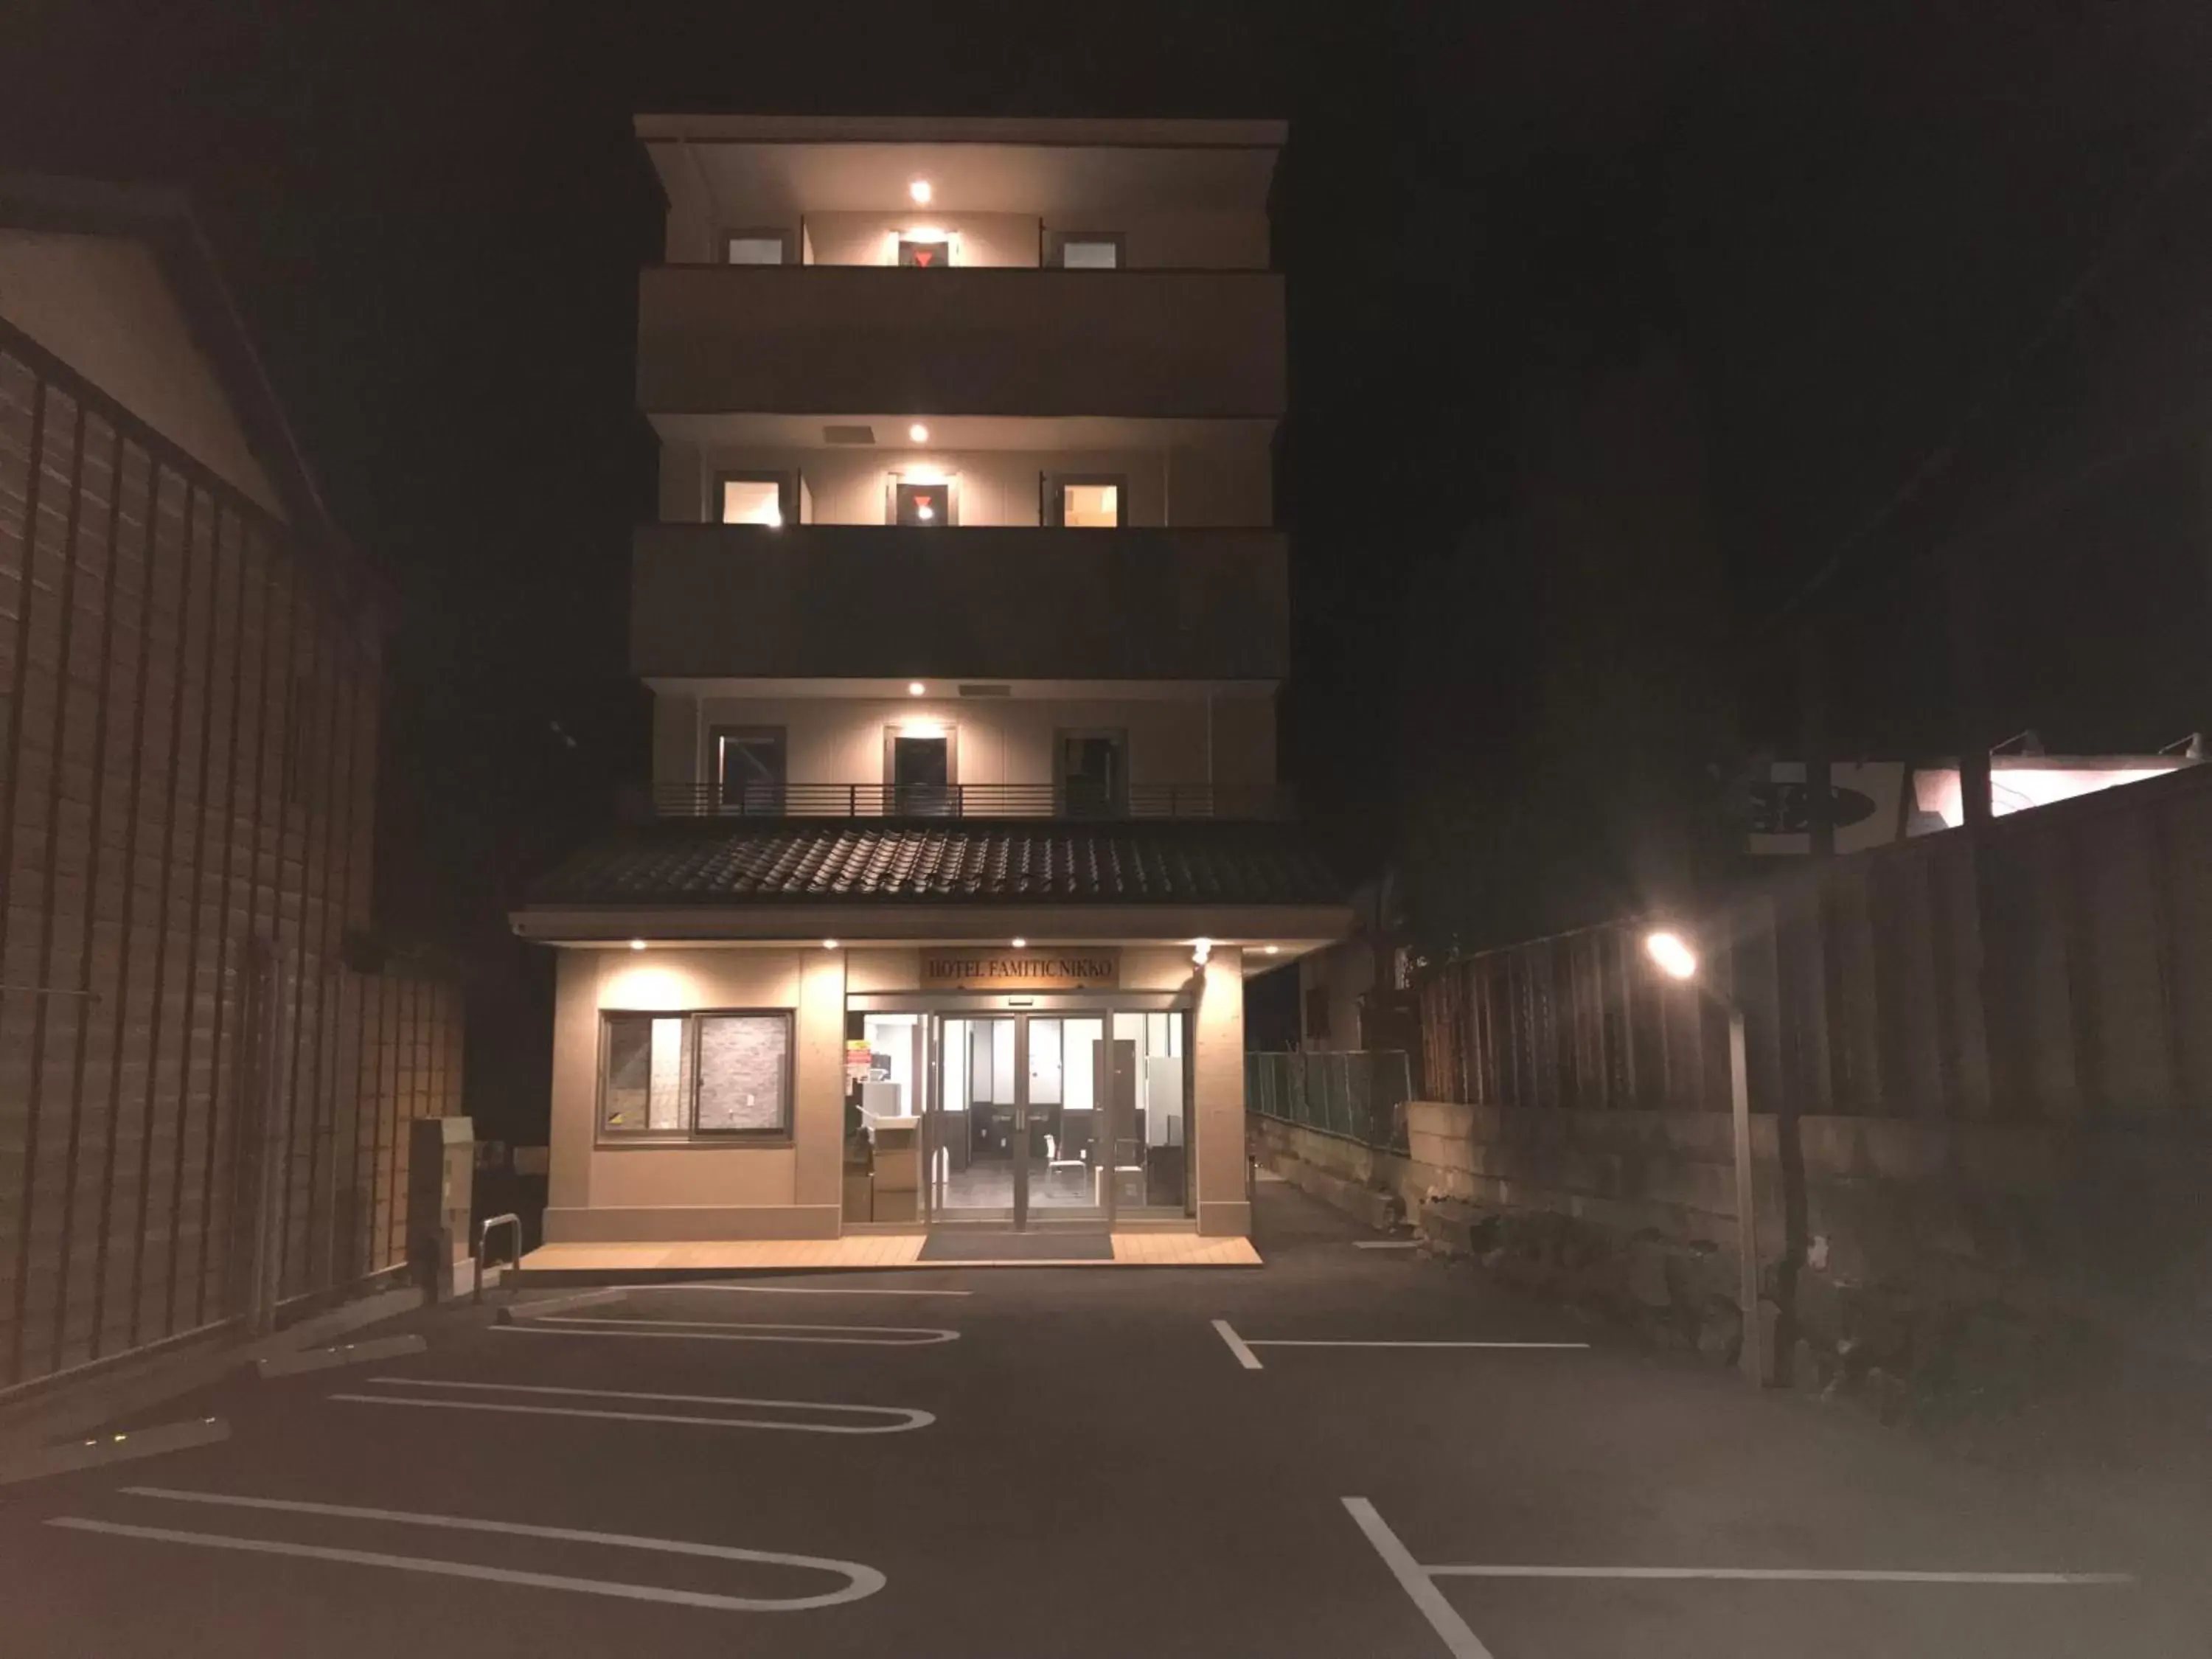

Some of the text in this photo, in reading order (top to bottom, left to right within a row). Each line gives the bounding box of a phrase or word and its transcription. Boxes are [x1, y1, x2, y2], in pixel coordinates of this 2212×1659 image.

[930, 959, 1112, 978] HOTEL FAMITIC NIKKO
